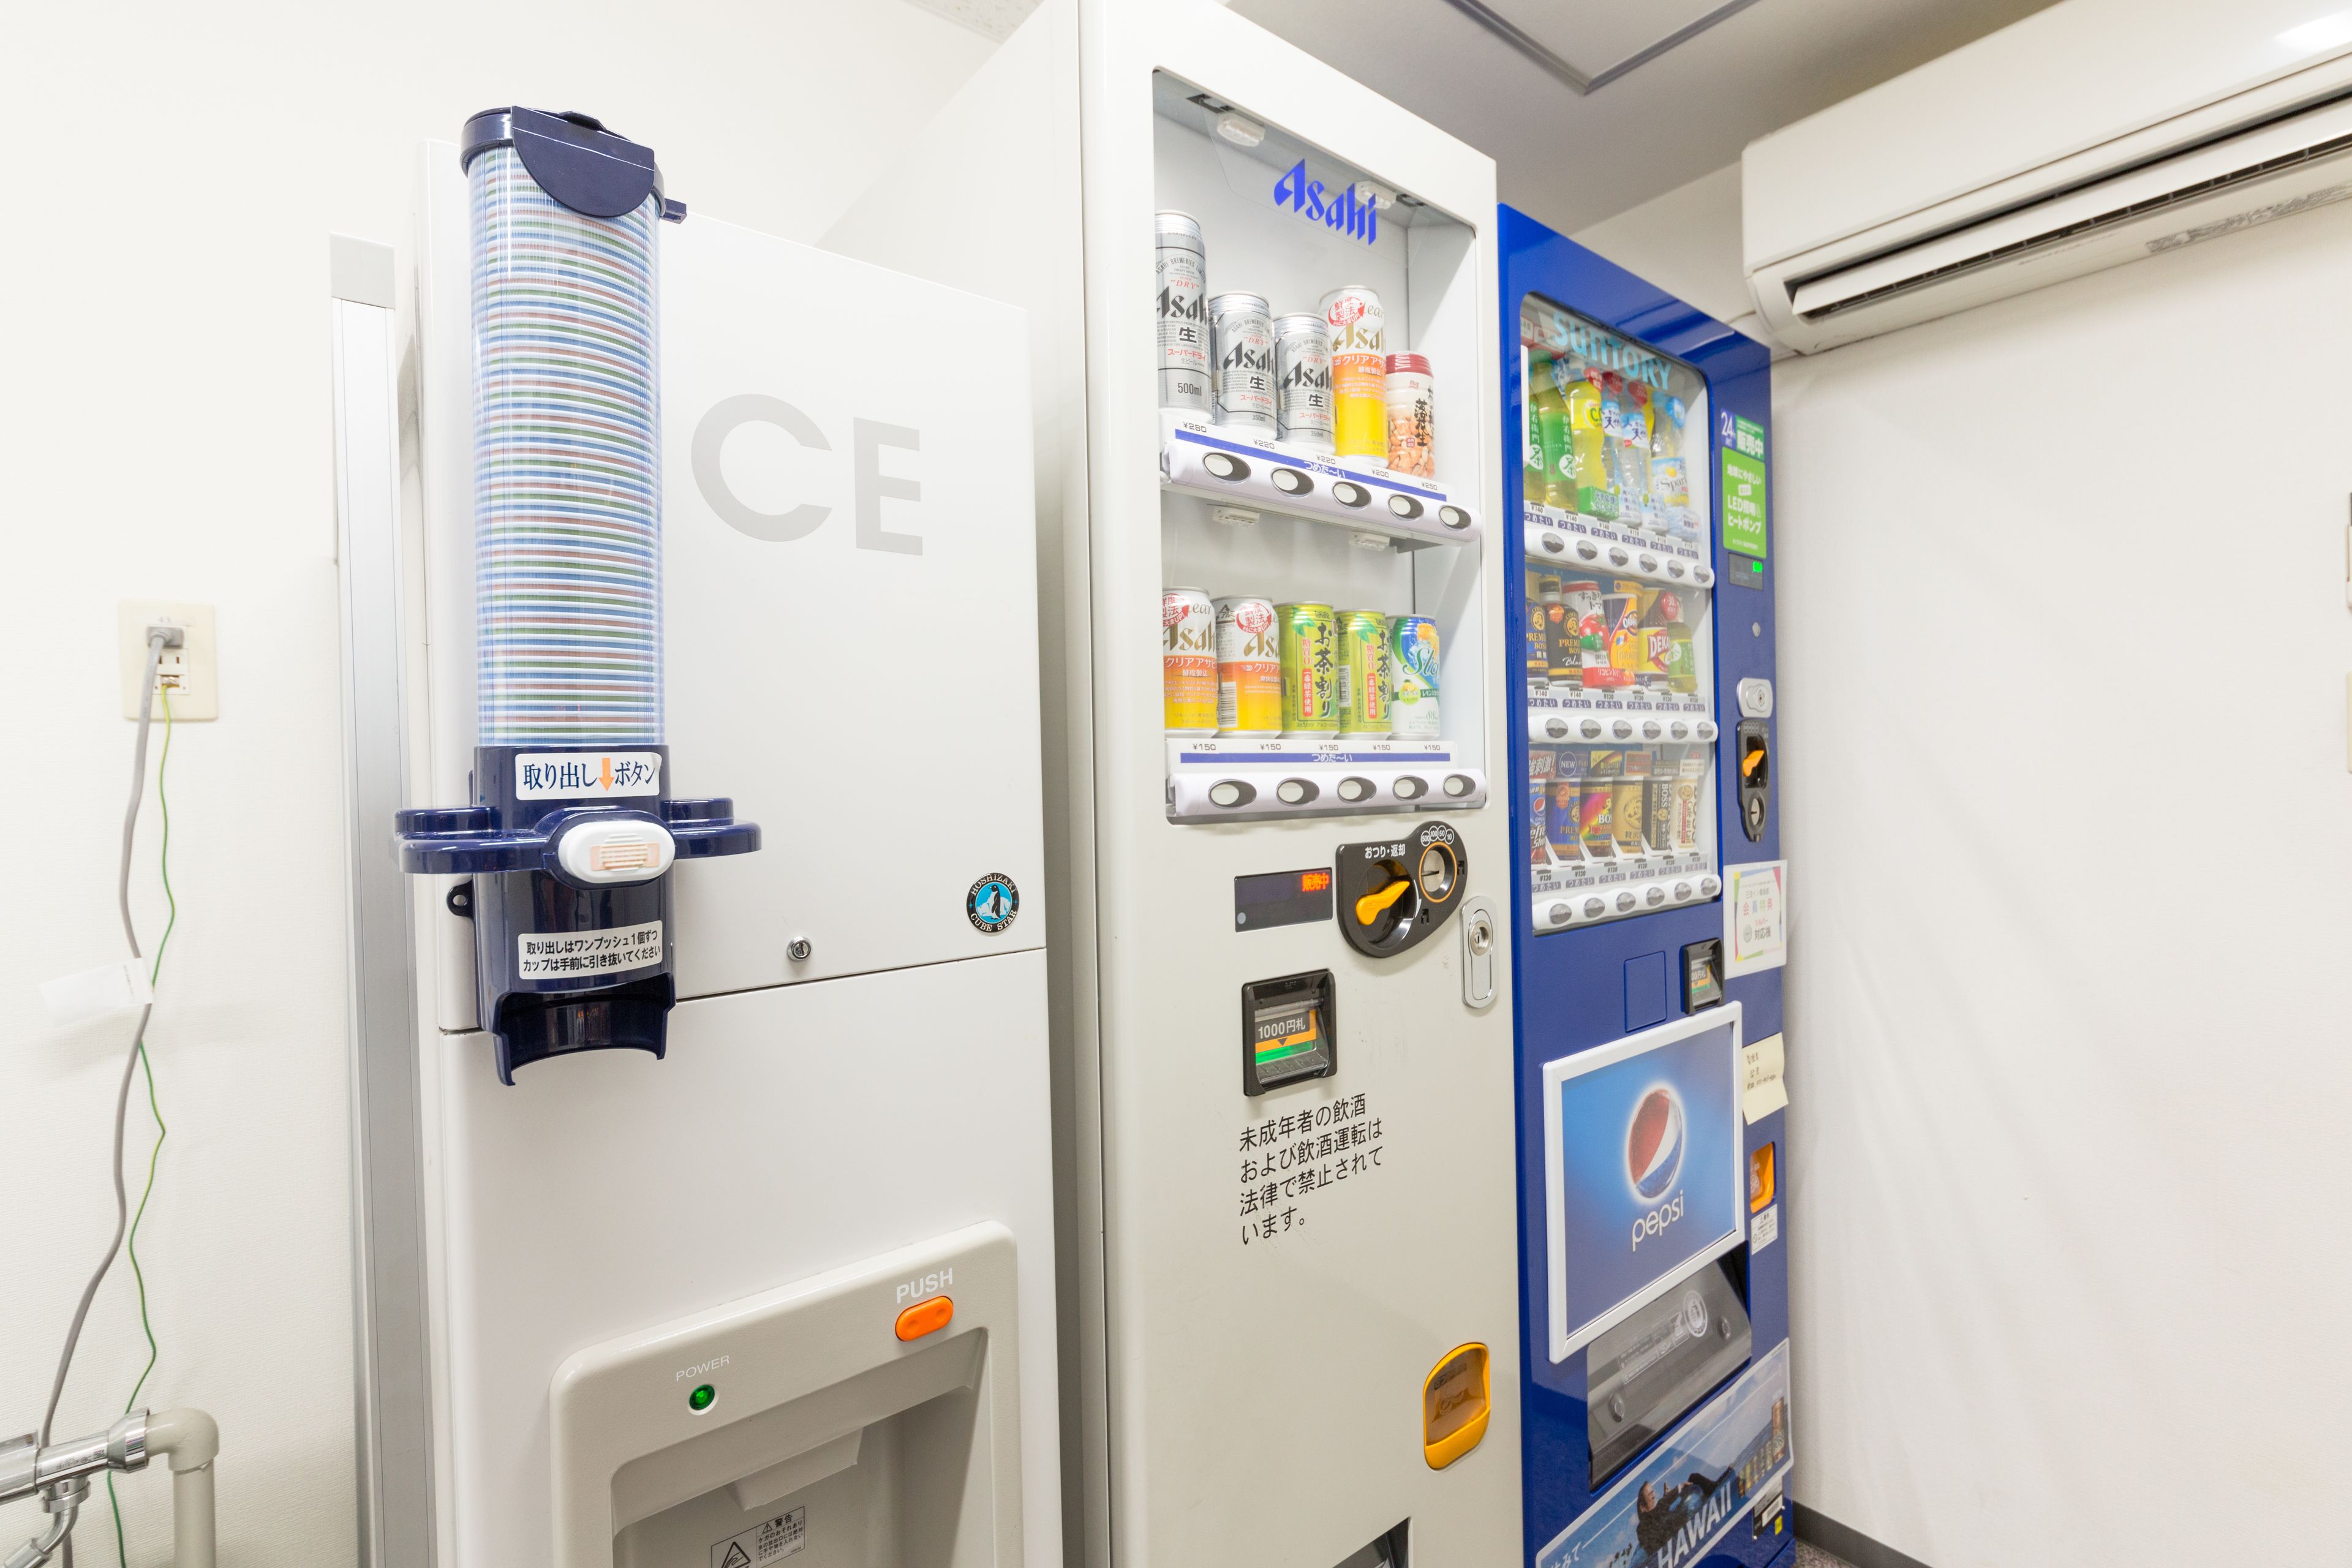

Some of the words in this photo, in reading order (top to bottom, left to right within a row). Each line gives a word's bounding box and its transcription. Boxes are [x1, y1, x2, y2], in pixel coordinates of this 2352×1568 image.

[1273, 157, 1377, 245] Asahi
[1170, 257, 1196, 268] BREWERIES
[1156, 286, 1208, 326] Asah
[1179, 326, 1197, 344] 生
[1333, 323, 1384, 353] Asa
[1223, 341, 1273, 375] Asah
[1343, 355, 1384, 368] クリアアサ
[1250, 376, 1265, 391] 生
[1283, 361, 1333, 392] Asah
[1178, 382, 1202, 397] 500ml
[1308, 394, 1324, 408] 生
[1183, 421, 1207, 433] ¥280
[1253, 439, 1275, 449] ¥220
[1316, 454, 1336, 465] ¥220
[690, 393, 924, 556] CE
[1371, 468, 1389, 478] ¥200
[1421, 481, 1438, 491] ¥250
[1589, 601, 1602, 610] トマ
[1163, 620, 1216, 653] Asah
[1526, 633, 1547, 641] PREMI
[1559, 639, 1580, 647] PREMI
[1649, 636, 1671, 658] DEKA
[1314, 622, 1333, 718] お茶割り
[1403, 647, 1439, 676] Sla
[1377, 629, 1390, 720] お茶割り
[1193, 742, 1216, 752] ¥150
[1260, 742, 1281, 752] ¥150
[1319, 743, 1338, 752] ¥150
[522, 761, 598, 790] 取り出し
[614, 761, 655, 787] ボタン
[1439, 829, 1446, 838] 50
[1447, 832, 1452, 841] 10
[1365, 843, 1406, 859] おつり・返却
[971, 873, 1017, 896] HOSHIZAKI
[1302, 873, 1330, 892] 販売中
[970, 913, 992, 932] CUBE
[997, 910, 1017, 930] STAR
[526, 930, 658, 956] 取り出しはワンプッシュ1個ずつ
[522, 944, 661, 973] カップは手前に引き抜いてください
[1691, 970, 1706, 981] 00円札
[1257, 1017, 1306, 1040] 1000円札
[1239, 1093, 1366, 1152] 未成年者の飲酒
[1240, 1117, 1383, 1183] および飲酒運転は
[1240, 1145, 1384, 1216] 法律で禁止されて
[1242, 1206, 1305, 1245] います。
[1631, 1189, 1684, 1253] pepsi
[895, 1268, 954, 1304] PUSH
[676, 1355, 730, 1382] POWER
[774, 1513, 793, 1528] 警告
[1657, 1481, 1732, 1568] HAWAII
[758, 1520, 802, 1544] ケガのおそれあり
[758, 1533, 804, 1556] に手や物を入れない
[759, 1548, 785, 1561] でください。
